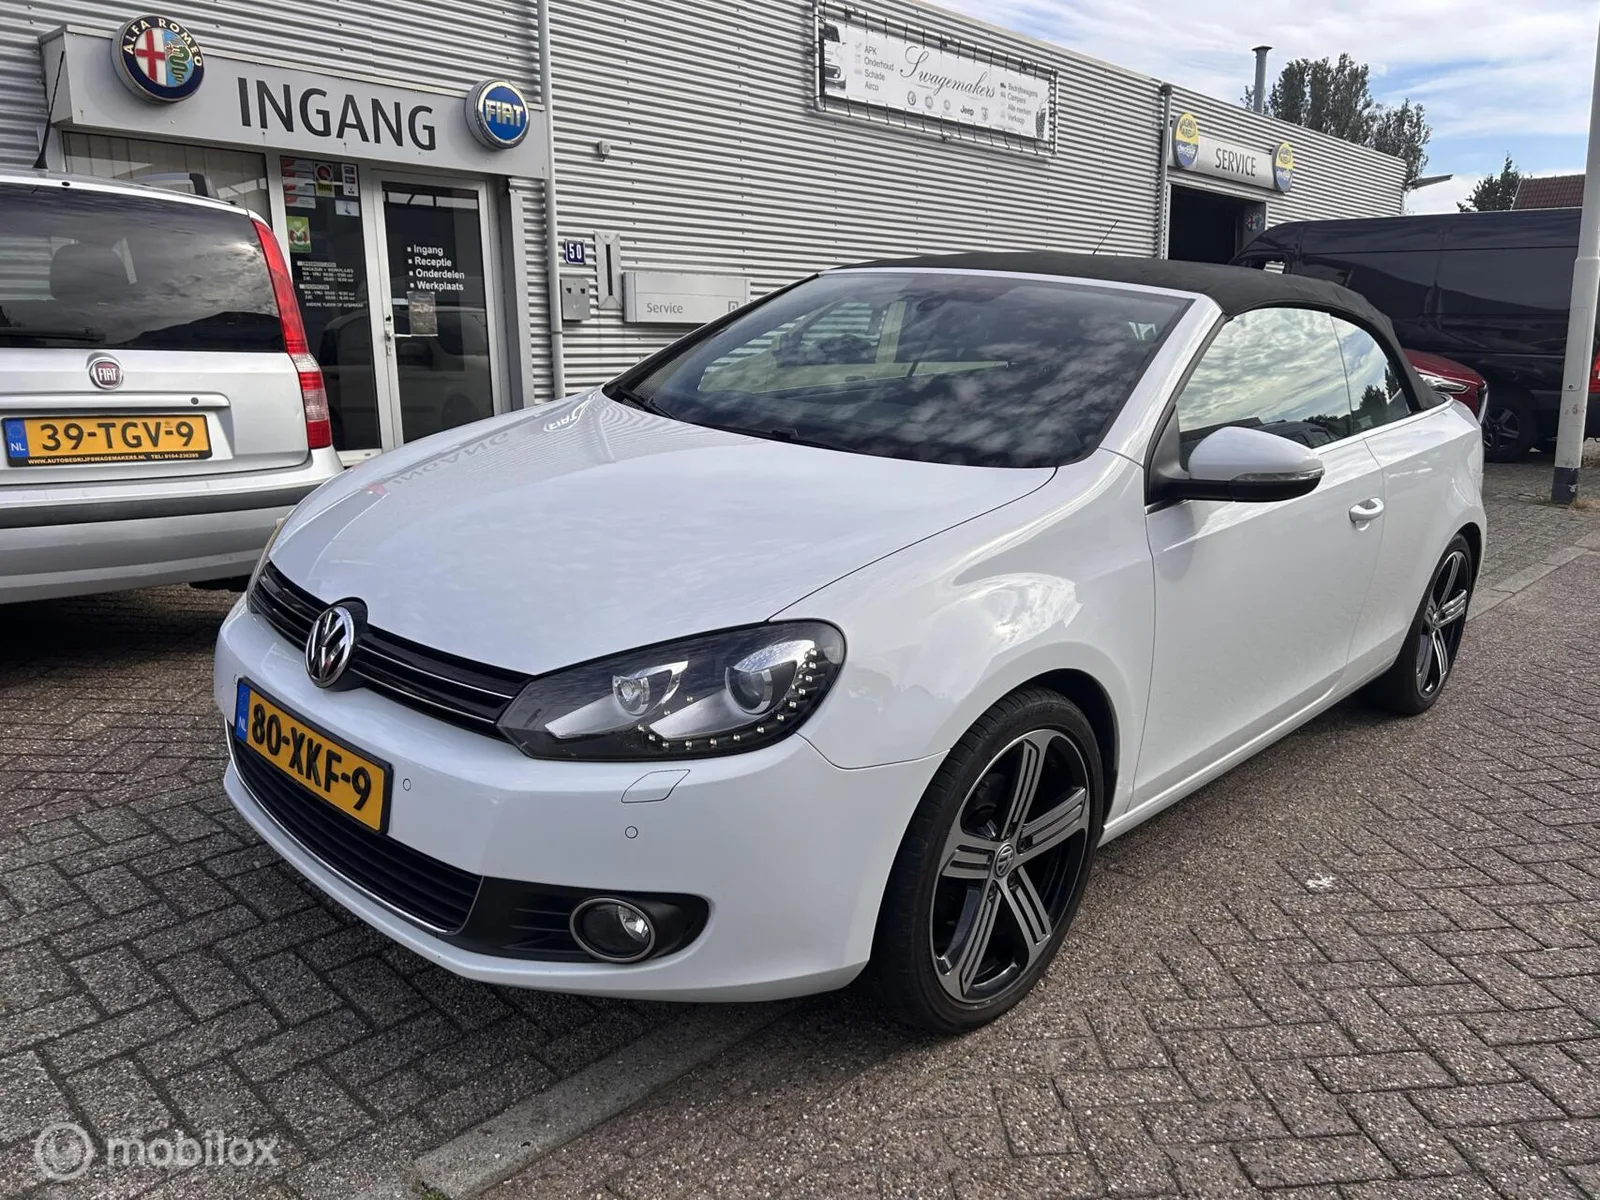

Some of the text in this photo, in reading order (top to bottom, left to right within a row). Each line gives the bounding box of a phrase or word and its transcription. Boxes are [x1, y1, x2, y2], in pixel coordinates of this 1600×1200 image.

[123, 18, 202, 66] ALFA ROMEO
[864, 45, 877, 55] APK
[864, 56, 895, 71] Onderhoud
[864, 68, 886, 81] Schade
[900, 45, 995, 98] Swagemakers
[864, 81, 880, 91] Airco
[237, 76, 436, 151] INGANG
[485, 99, 524, 127] FIAT
[960, 105, 975, 117] Jeep
[1215, 147, 1257, 177] SERVICE
[413, 244, 444, 257] Ingang
[568, 243, 583, 260] 50
[414, 256, 452, 268] Receptie
[415, 268, 465, 279] Onderdelen
[416, 280, 464, 292] Werkplaats
[646, 302, 684, 314] Service
[97, 367, 117, 381] FIAT
[40, 421, 194, 451] 39-TGV-9
[10, 442, 26, 452] NL
[238, 715, 248, 733] NL
[251, 703, 372, 811] 80-XKF-9
